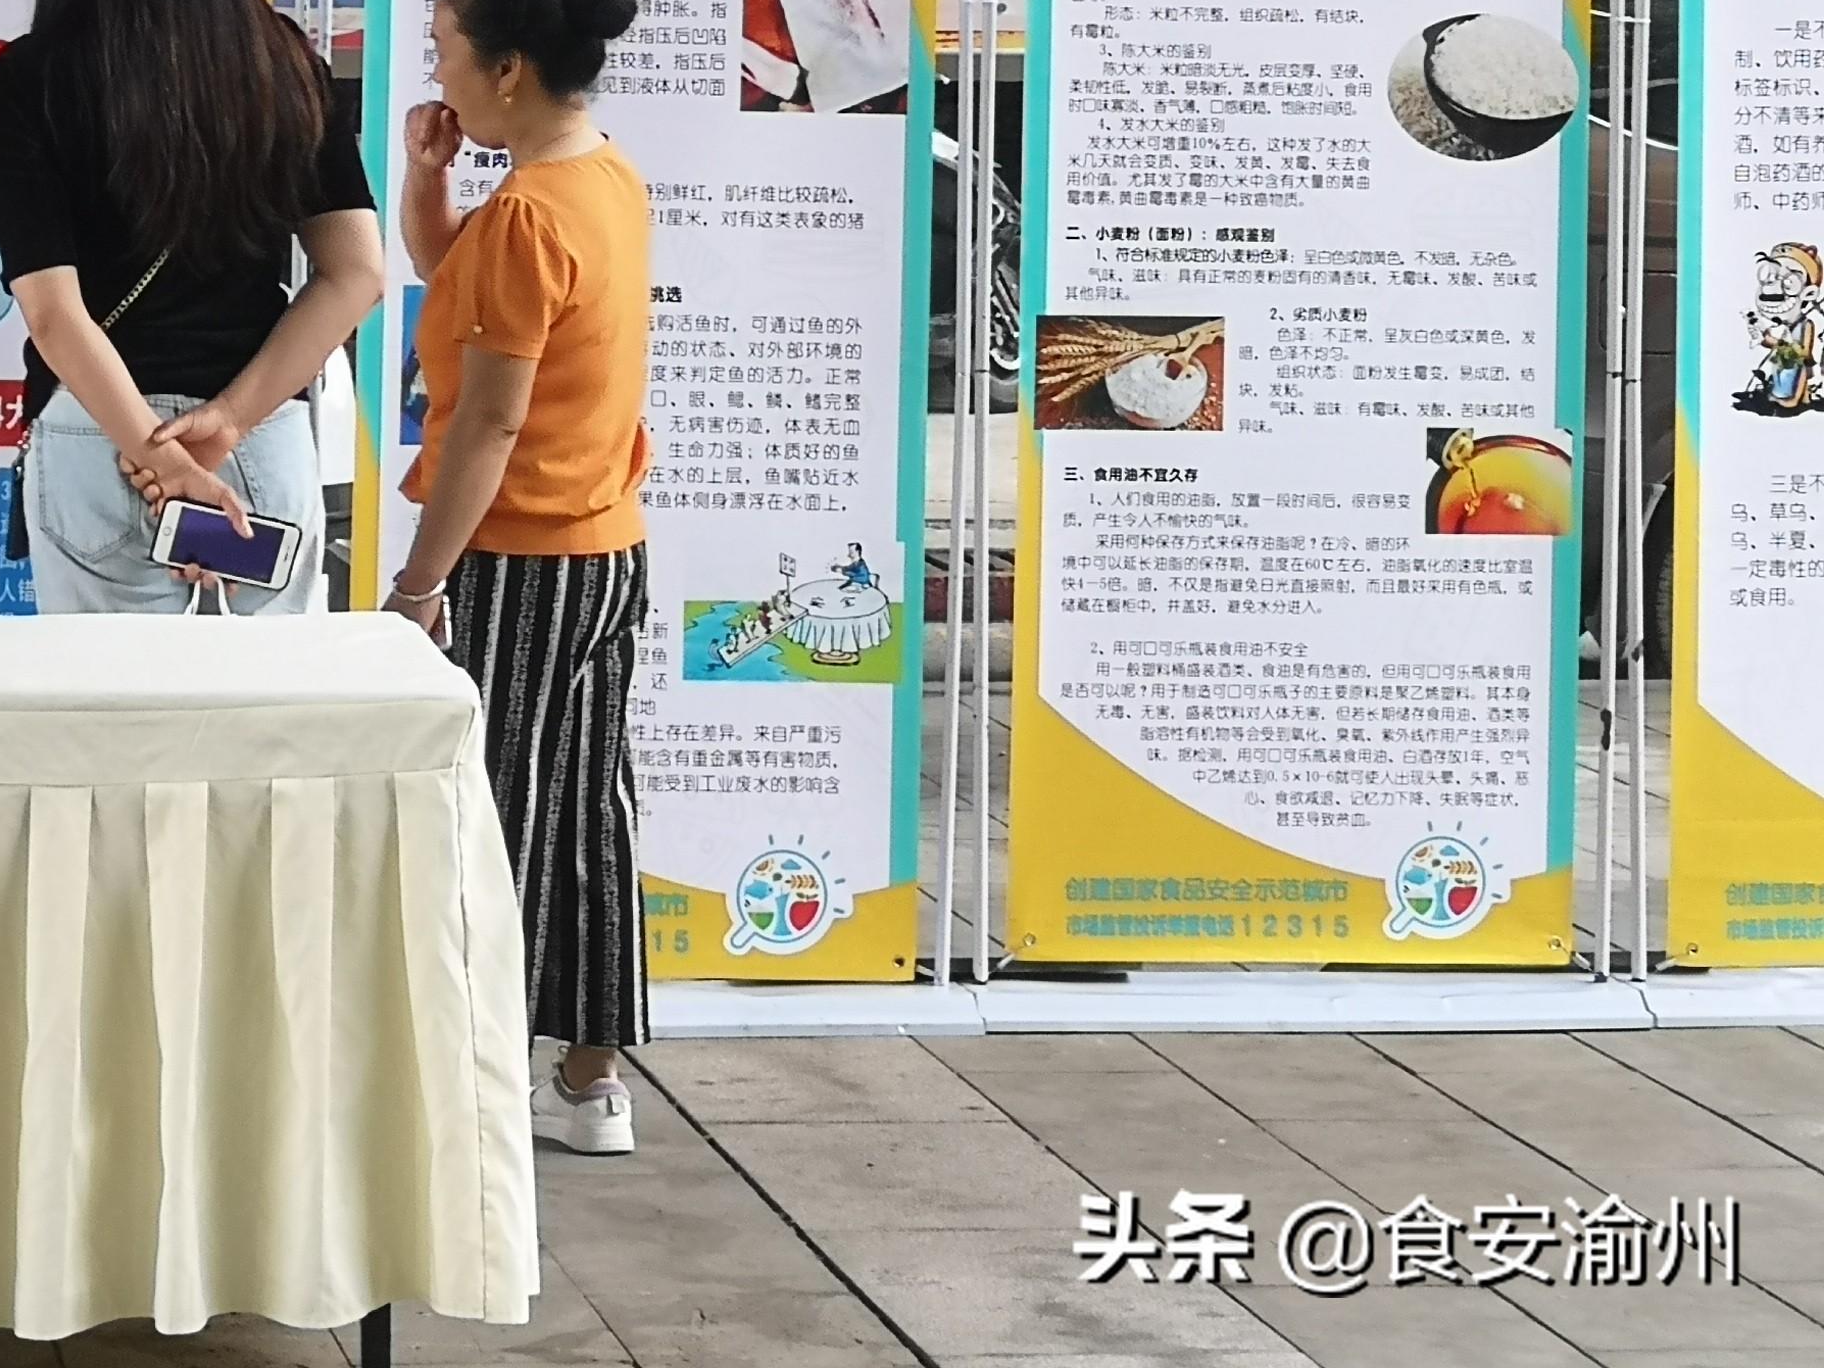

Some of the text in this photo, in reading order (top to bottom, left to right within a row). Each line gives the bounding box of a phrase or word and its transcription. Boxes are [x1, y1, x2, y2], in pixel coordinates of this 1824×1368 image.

[600, 76, 726, 97] 见到液体从切面
[643, 340, 863, 361] 动的状态、对外部环境的
[645, 365, 862, 385] 度来判定鱼的活力。正常
[640, 416, 861, 437] ，无病害伤迹，体表无血
[1064, 467, 1198, 483] 三、食用油不宜久存
[631, 749, 839, 770] 能含有重金属等有害物质，
